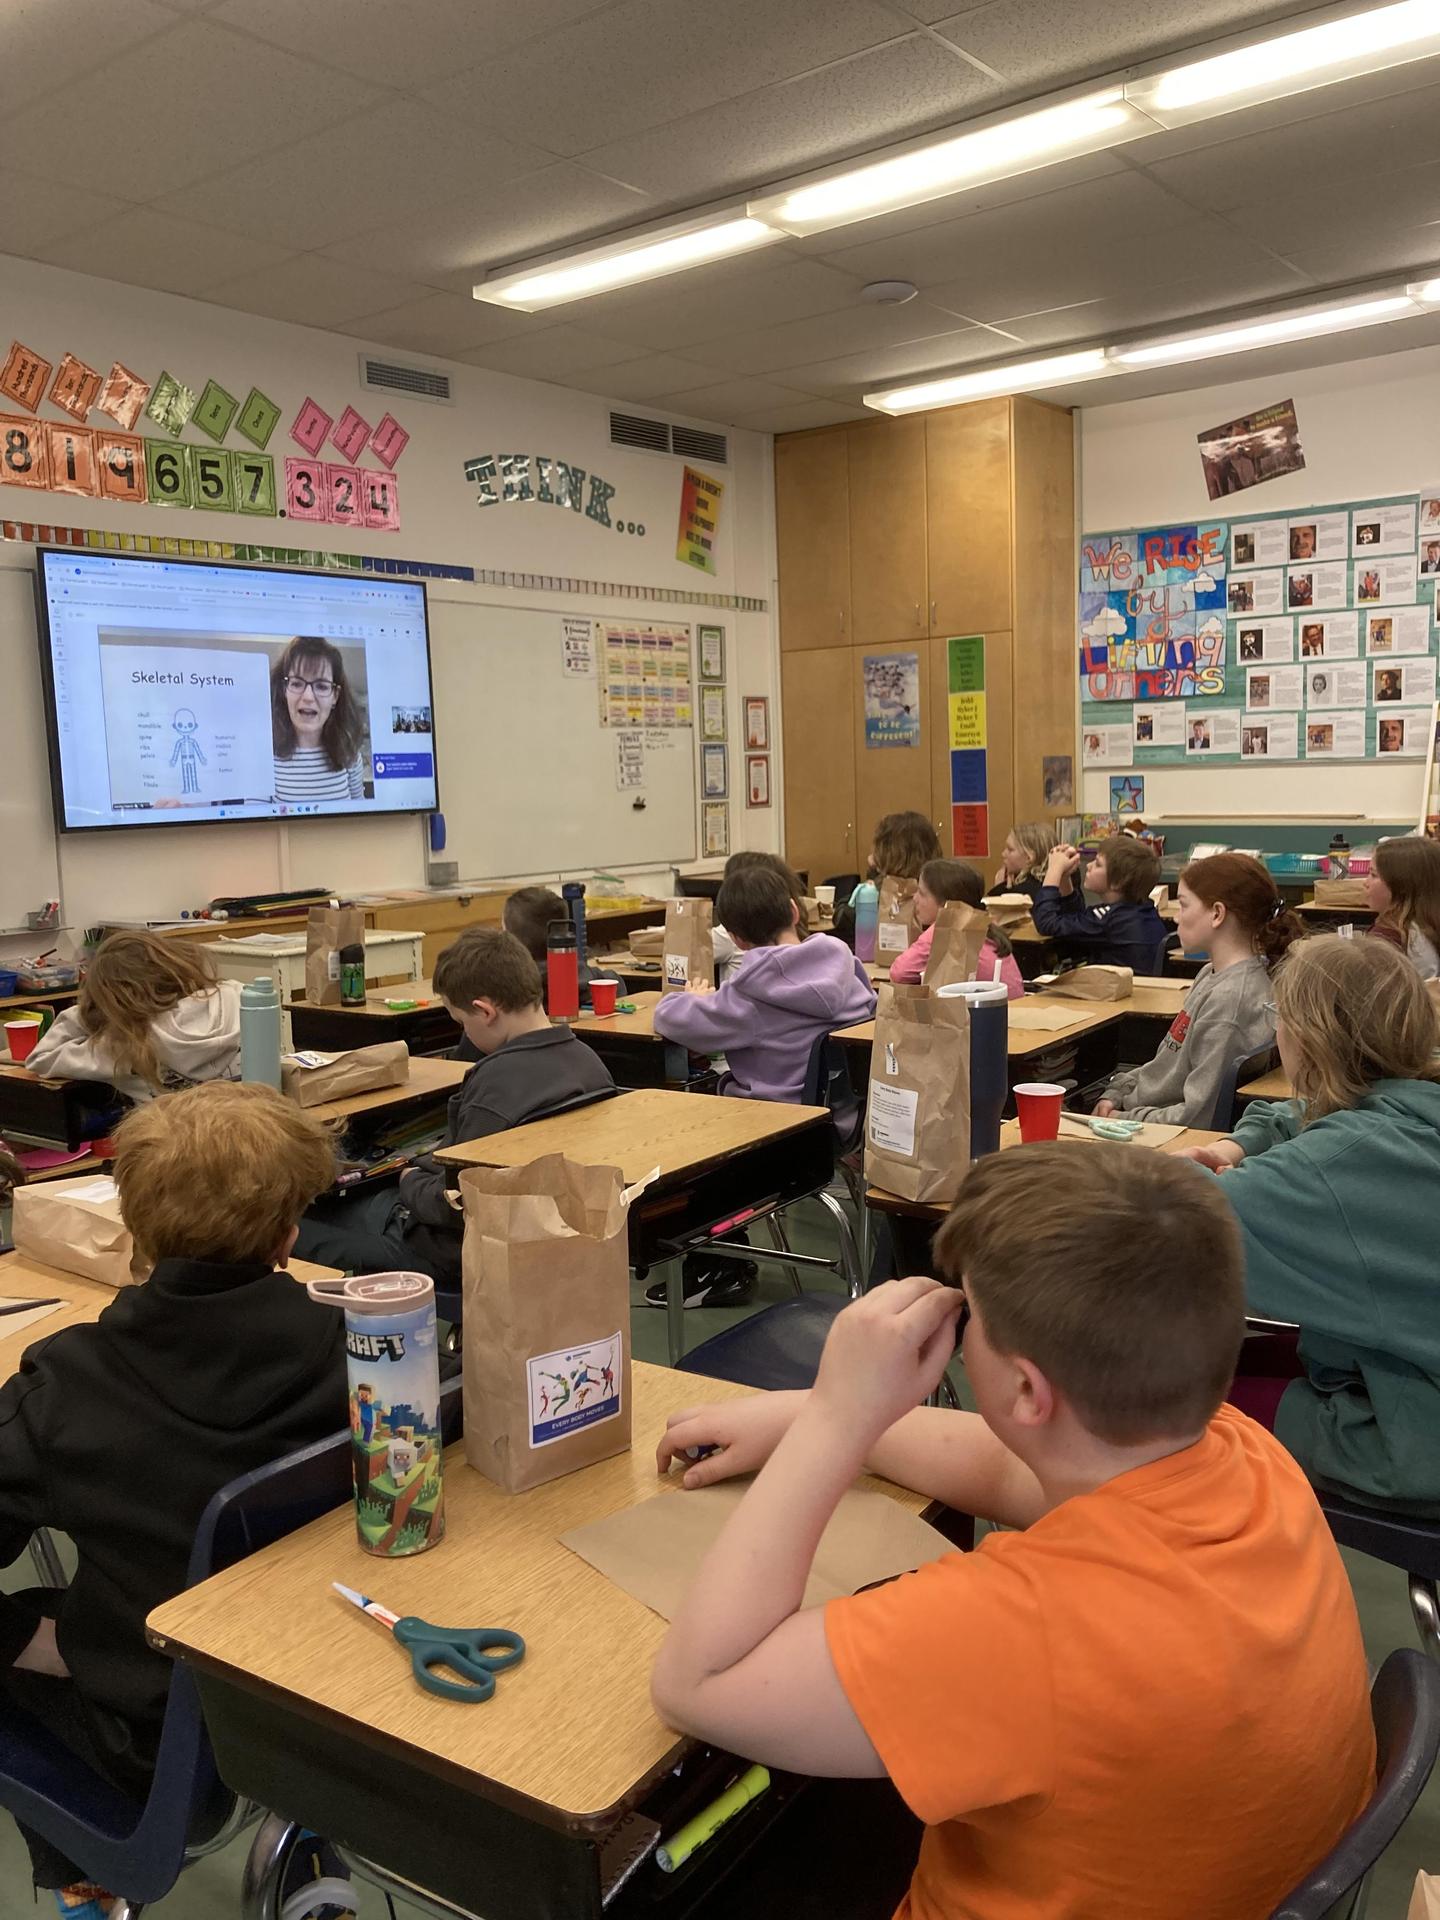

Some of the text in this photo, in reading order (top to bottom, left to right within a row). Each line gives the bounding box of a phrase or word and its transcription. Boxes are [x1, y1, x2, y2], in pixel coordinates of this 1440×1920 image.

[5, 429, 32, 474] 8
[66, 437, 76, 481] 1
[155, 453, 179, 494] 6
[200, 459, 224, 499] 5
[244, 465, 264, 503] 7
[295, 470, 316, 508] 3
[335, 476, 354, 514] 2
[370, 483, 389, 518] 4
[1144, 528, 1225, 576] RISE
[131, 670, 234, 688] Skeletal System
[346, 1331, 406, 1362] RAFT
[570, 1412, 586, 1423] BODY
